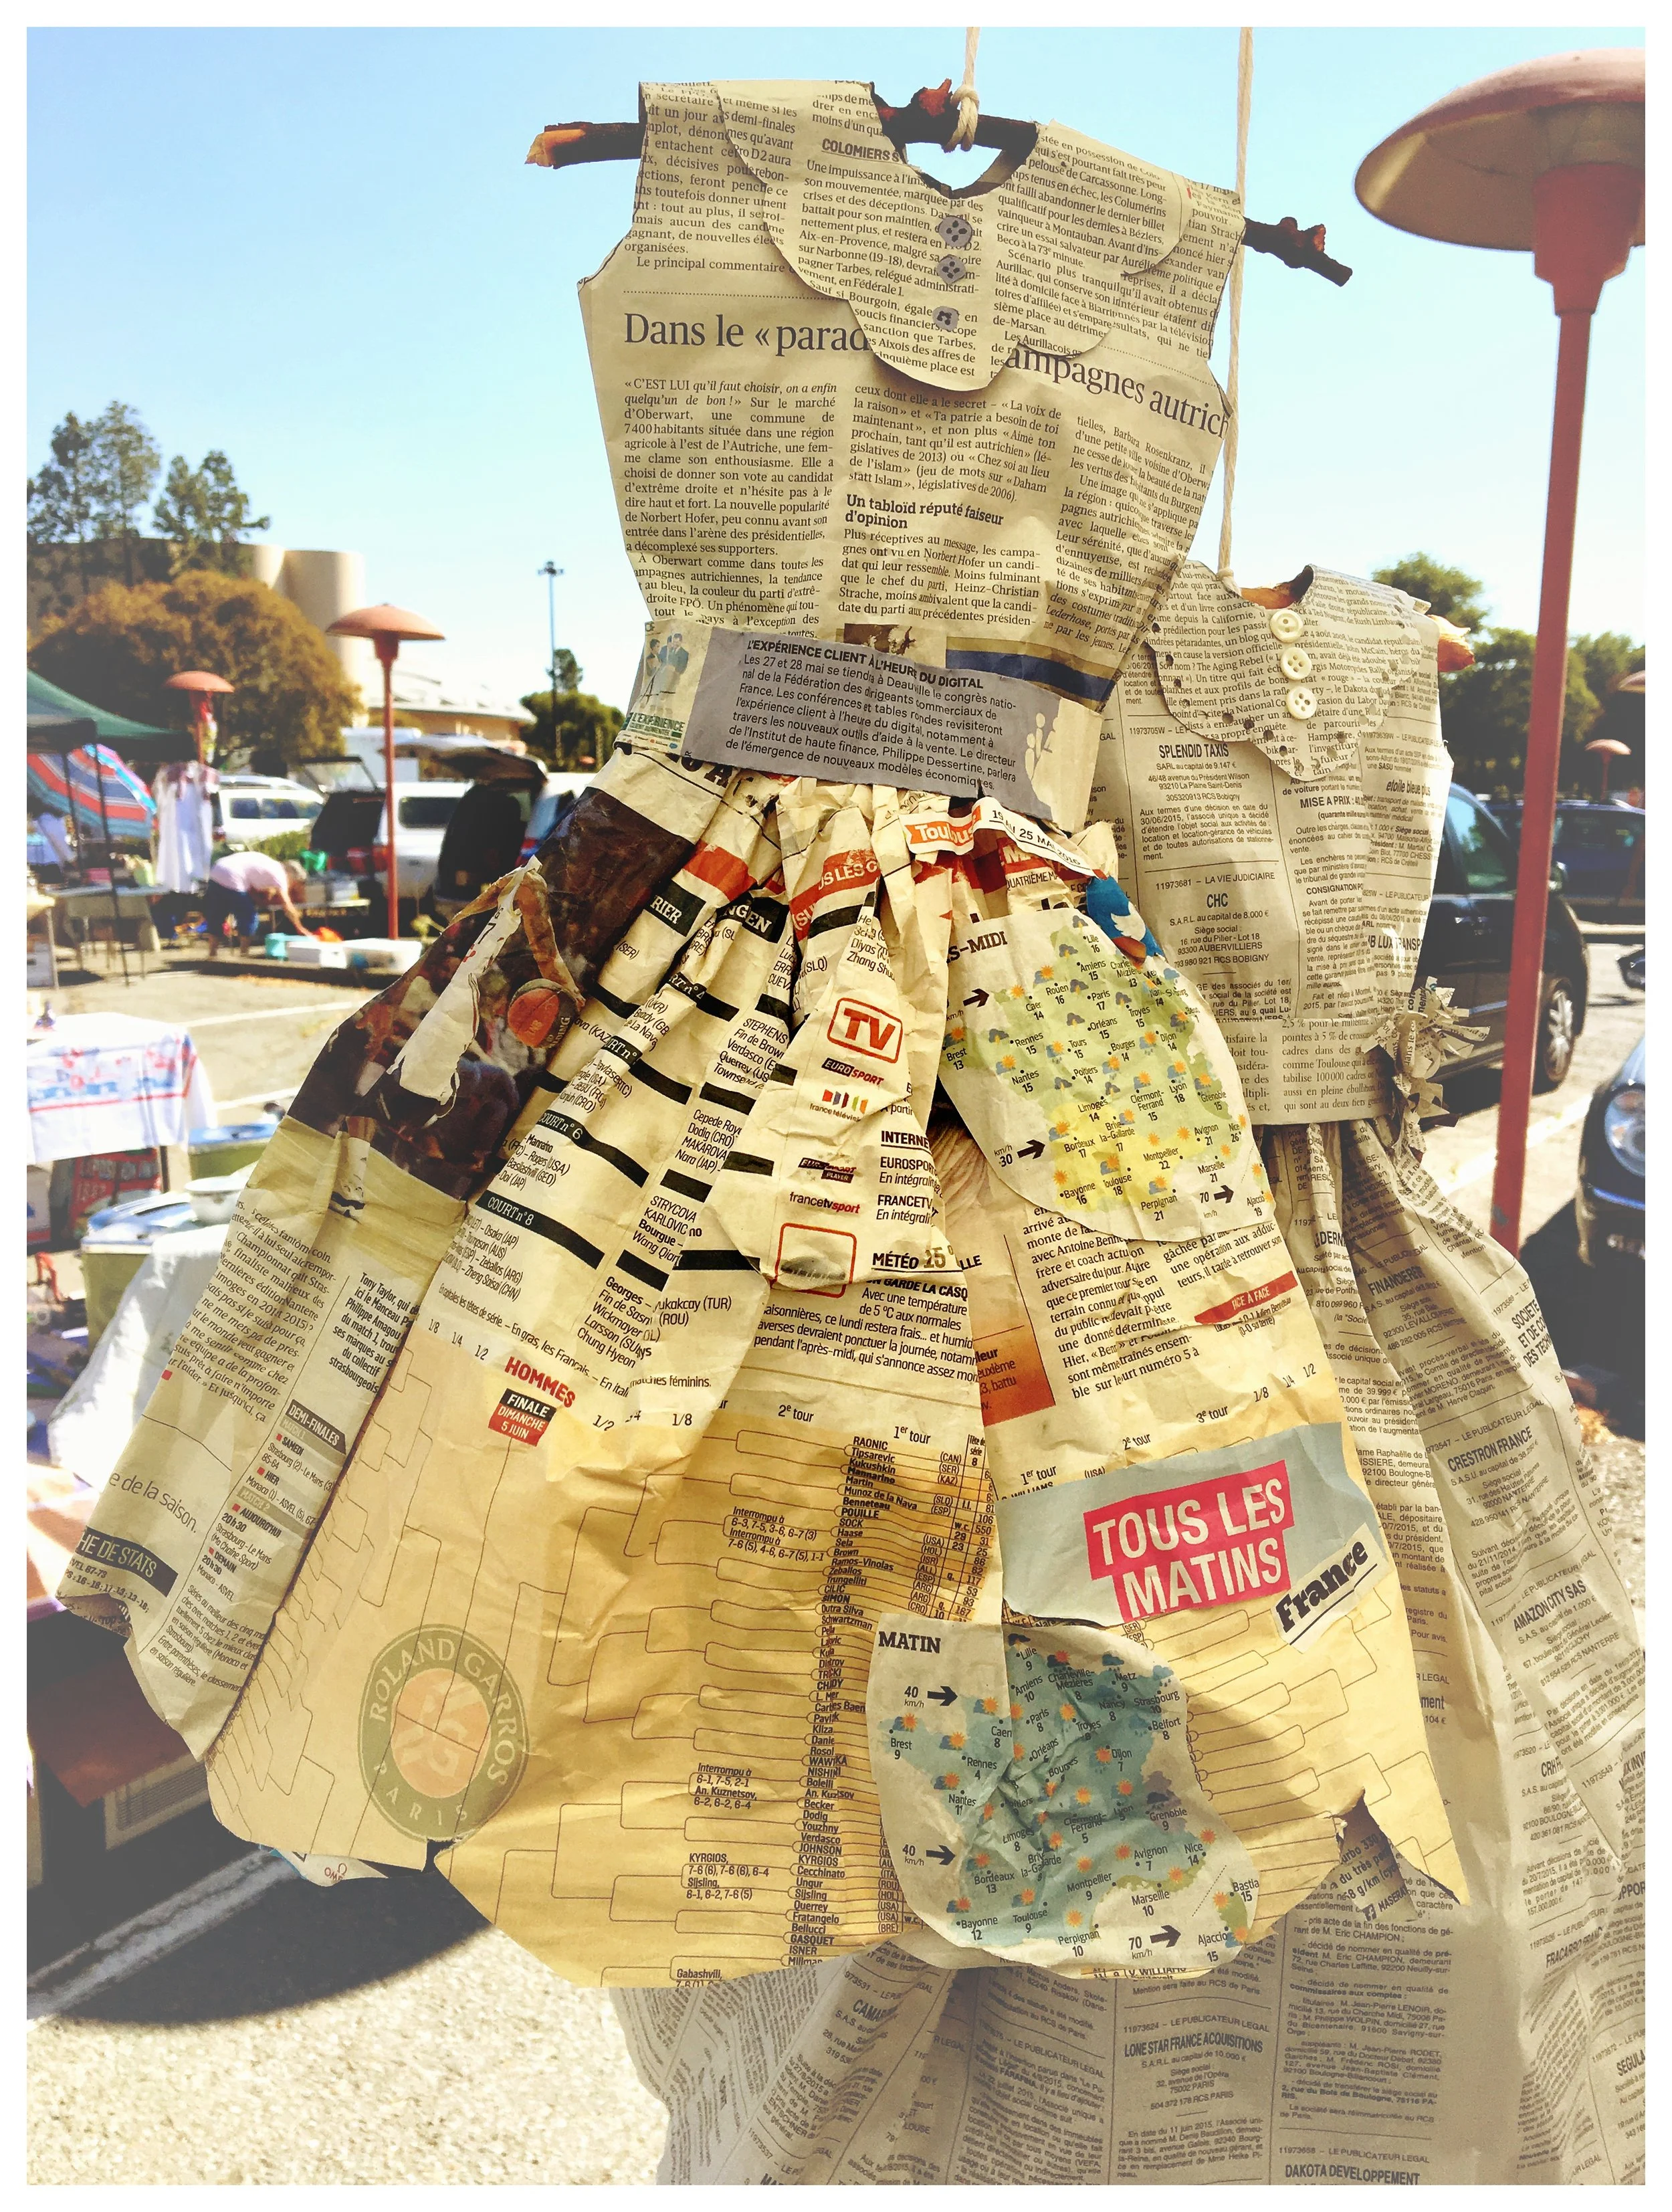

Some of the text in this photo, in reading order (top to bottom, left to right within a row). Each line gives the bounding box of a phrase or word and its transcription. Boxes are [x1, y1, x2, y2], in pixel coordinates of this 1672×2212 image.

[821, 138, 890, 163] COLOMIERS
[1080, 171, 1139, 197] Carcassonne.
[1192, 207, 1232, 226] pouvoir.
[625, 243, 688, 254] organisées.
[637, 256, 785, 274] Le principal commentaire
[624, 313, 705, 346] Dans
[716, 314, 744, 347] le
[670, 380, 689, 390] LUI
[694, 381, 716, 393] qu'il
[718, 381, 741, 393] faut
[744, 381, 782, 395] choisir,
[811, 383, 837, 395] enfin
[625, 408, 693, 421] d'Oberwart,
[750, 415, 805, 423] commune
[822, 411, 834, 422] de
[847, 494, 1004, 525] Un tabloïd réputé faiseur
[845, 508, 908, 528] d'opinion
[955, 583, 1039, 598] Heinz-Christian
[747, 639, 983, 689] L'EXPÉRIENCE CLIENT À L'HEURE DU DIGITAL
[1159, 743, 1229, 759] SPLENDID TAXIS
[726, 738, 995, 791] de l'émergence de nouveaux modèles économiqes.
[1019, 829, 1033, 839] 25
[1057, 848, 1080, 864] 2016
[1006, 872, 1048, 891] QUATRIÈME
[1217, 874, 1232, 882] VIE
[1233, 872, 1275, 882] JUDICIAIRE
[1207, 893, 1228, 908] CHC
[1091, 944, 1100, 953] 16
[1198, 942, 1262, 952] AUBERVILLIERS
[1080, 960, 1106, 973] Amiens
[1089, 971, 1098, 981] 15
[1091, 990, 1110, 1001] Paris
[1096, 1001, 1105, 1011] 17
[843, 1007, 896, 1051] TV
[1015, 1033, 1045, 1047] Rennes
[946, 1047, 967, 1062] Brest
[1026, 1045, 1037, 1055] 15
[953, 1060, 964, 1070] 13
[1169, 1083, 1188, 1094] Lyon
[1130, 1090, 1164, 1104] Clermont-
[1174, 1094, 1185, 1103] 18
[1138, 1099, 1164, 1112] Ferrand
[1148, 1112, 1158, 1121] 15
[999, 1154, 1013, 1167] 30
[1143, 1148, 1178, 1162] Montpellier
[1158, 1161, 1170, 1170] 22
[1198, 1161, 1225, 1175] Marseille
[1210, 1173, 1217, 1183] 21
[789, 1192, 860, 1214] francetvsport
[1198, 1191, 1209, 1203] 70
[487, 1197, 518, 1221] COURT
[871, 1251, 921, 1272] MÉTÉO
[753, 1336, 857, 1362] pendant l'après-midi,
[504, 1356, 575, 1409] HOMMES
[506, 1393, 550, 1418] FINALE
[288, 1403, 340, 1446] DEMI-FINALES
[498, 1406, 546, 1431] DIMANCHE
[501, 1421, 530, 1439] 5 JUIN
[910, 1431, 931, 1444] tour
[282, 1437, 304, 1456] SAMEDI
[853, 1436, 962, 1464] RAONIC (CAN)
[1447, 1426, 1533, 1472] CRESTRON FRANCE
[851, 1447, 895, 1464] Tipsarevic
[121, 1475, 196, 1533] de la saison.
[841, 1507, 880, 1519] POUILLE
[1093, 1478, 1285, 1565] TOUS LES
[97, 1540, 120, 1562] DE
[118, 1546, 157, 1579] STATS
[1122, 1537, 1281, 1619] MATINS
[1275, 1542, 1368, 1633] France
[1513, 1580, 1586, 1631] AMAZON CITY SAS
[879, 1631, 941, 1653] MATIN
[1021, 1647, 1037, 1660] Lille
[1026, 1661, 1032, 1671] 9
[904, 1686, 918, 1698] 40
[904, 1699, 924, 1708] km/h
[369, 1638, 517, 1785] ROLAND GARROS
[1029, 1708, 1049, 1724] Paris
[1037, 1722, 1043, 1732] 8
[1152, 1717, 1181, 1730] Belfort
[1162, 1730, 1170, 1740] 8
[891, 1737, 912, 1750] Brest
[895, 1749, 900, 1760] 9
[373, 1760, 467, 1826] PARIS
[689, 1853, 729, 1864] KYRGIOS,
[1134, 1845, 1168, 1860] Avignon
[1146, 1861, 1151, 1871] 7
[1233, 1879, 1259, 1892] Bastia
[1132, 1890, 1170, 1906] Marseille
[1241, 1890, 1252, 1902] 15
[794, 1900, 828, 1913] Querrey
[1142, 1905, 1154, 1916] 10
[1013, 1910, 1050, 1923] Toulouse
[960, 1917, 999, 1932] Bayonne
[1025, 1923, 1033, 1933] 9
[791, 1934, 835, 1945] GASQUET
[971, 1930, 982, 1940] 12
[1124, 2032, 1263, 2057] LONE STAR FRANCE ACQUISITIONS
[1284, 2163, 1421, 2185] DAKOTA DEVELOPPEMENT
